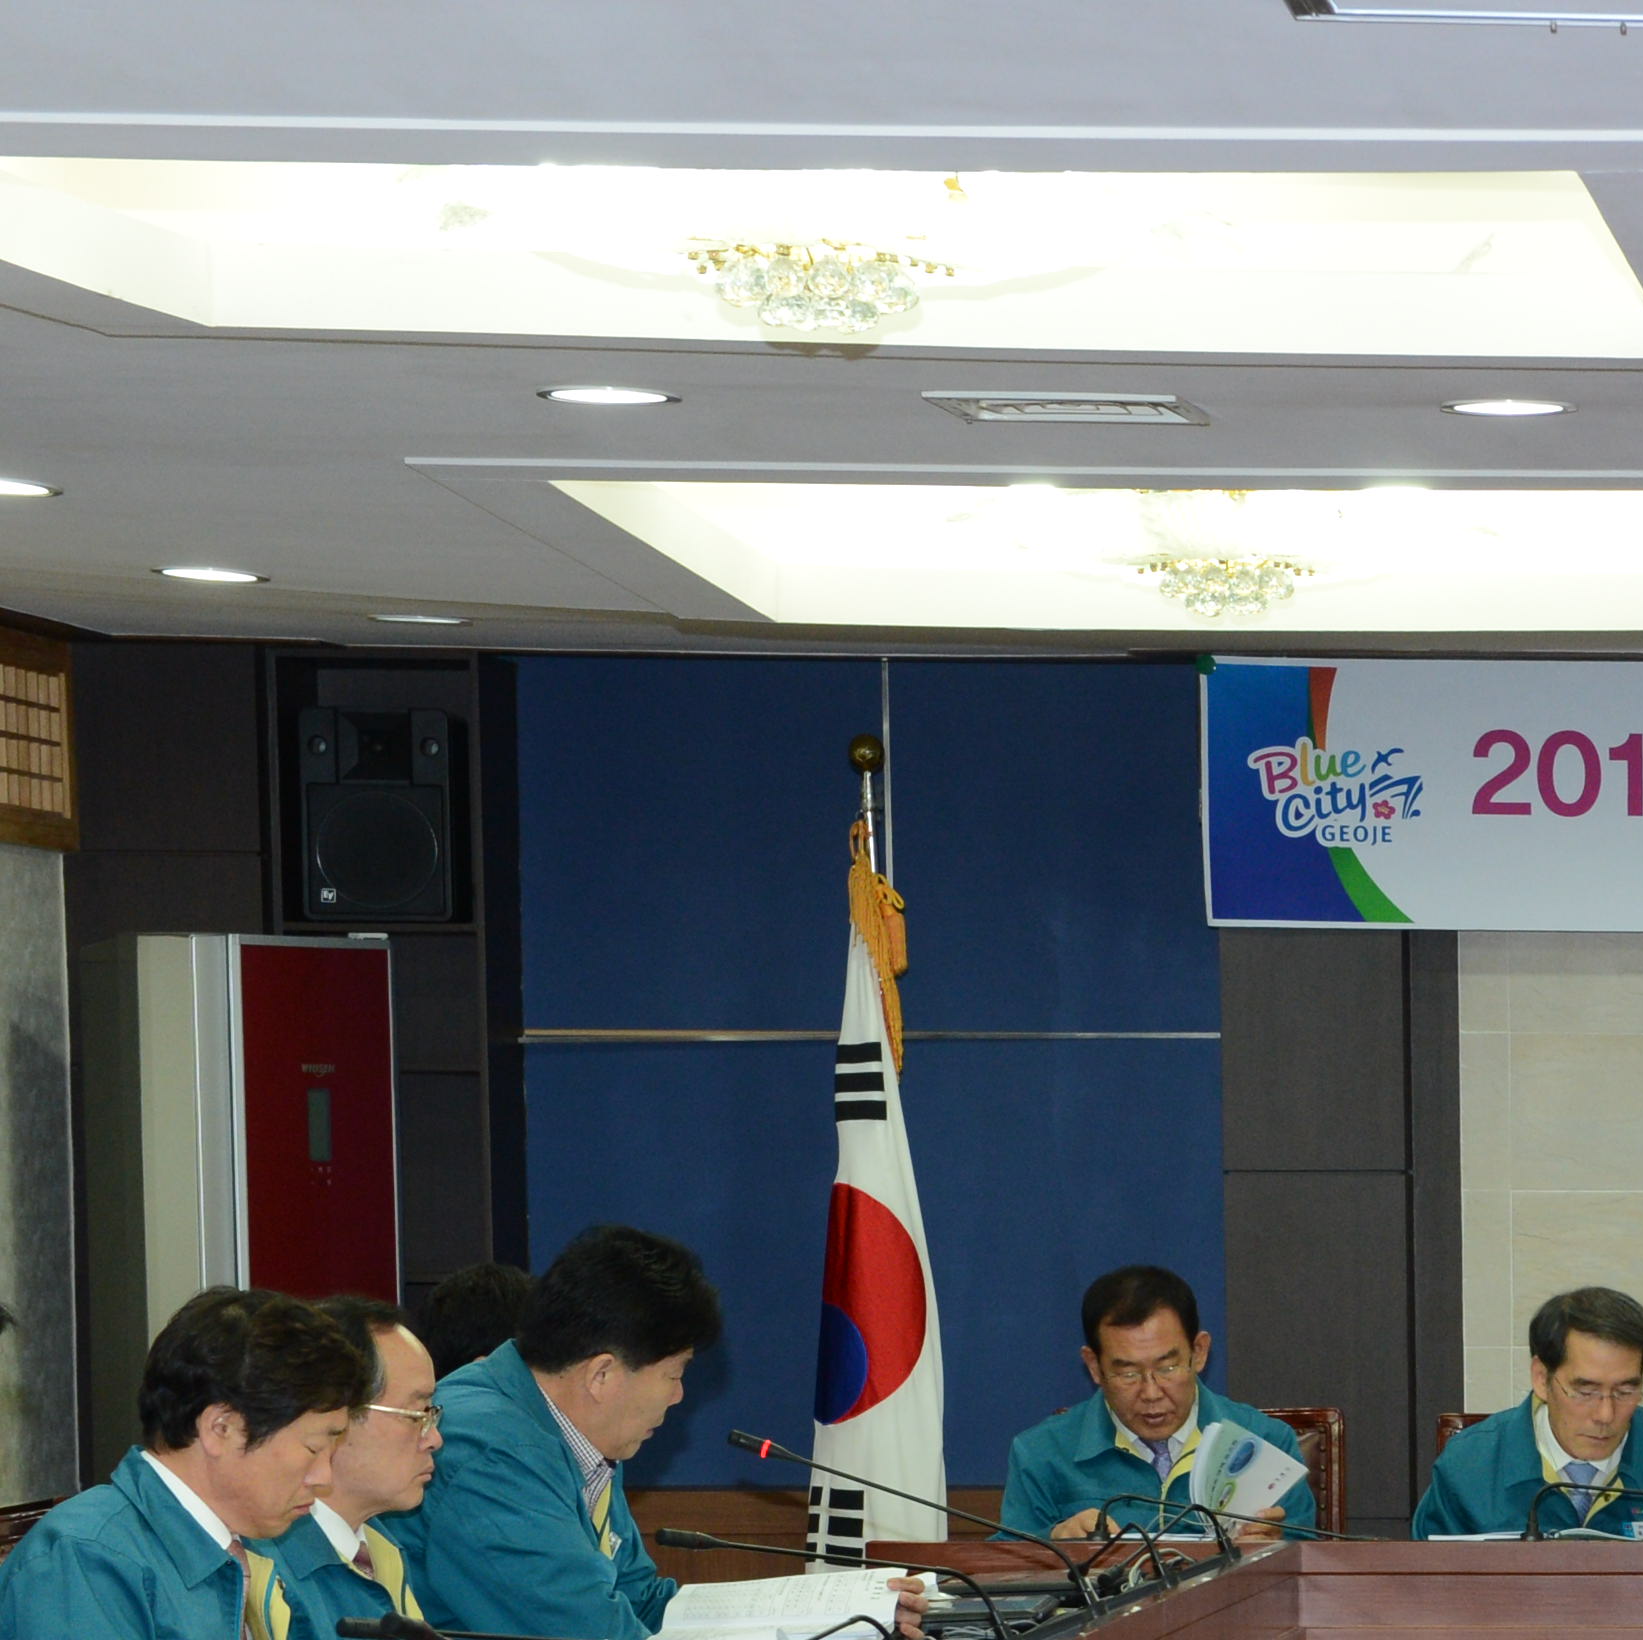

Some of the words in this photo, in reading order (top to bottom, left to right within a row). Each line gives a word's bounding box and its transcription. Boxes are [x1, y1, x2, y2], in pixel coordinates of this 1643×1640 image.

[1253, 741, 1367, 795] Blue
[1281, 781, 1368, 832] City
[1321, 824, 1393, 846] GEOJE
